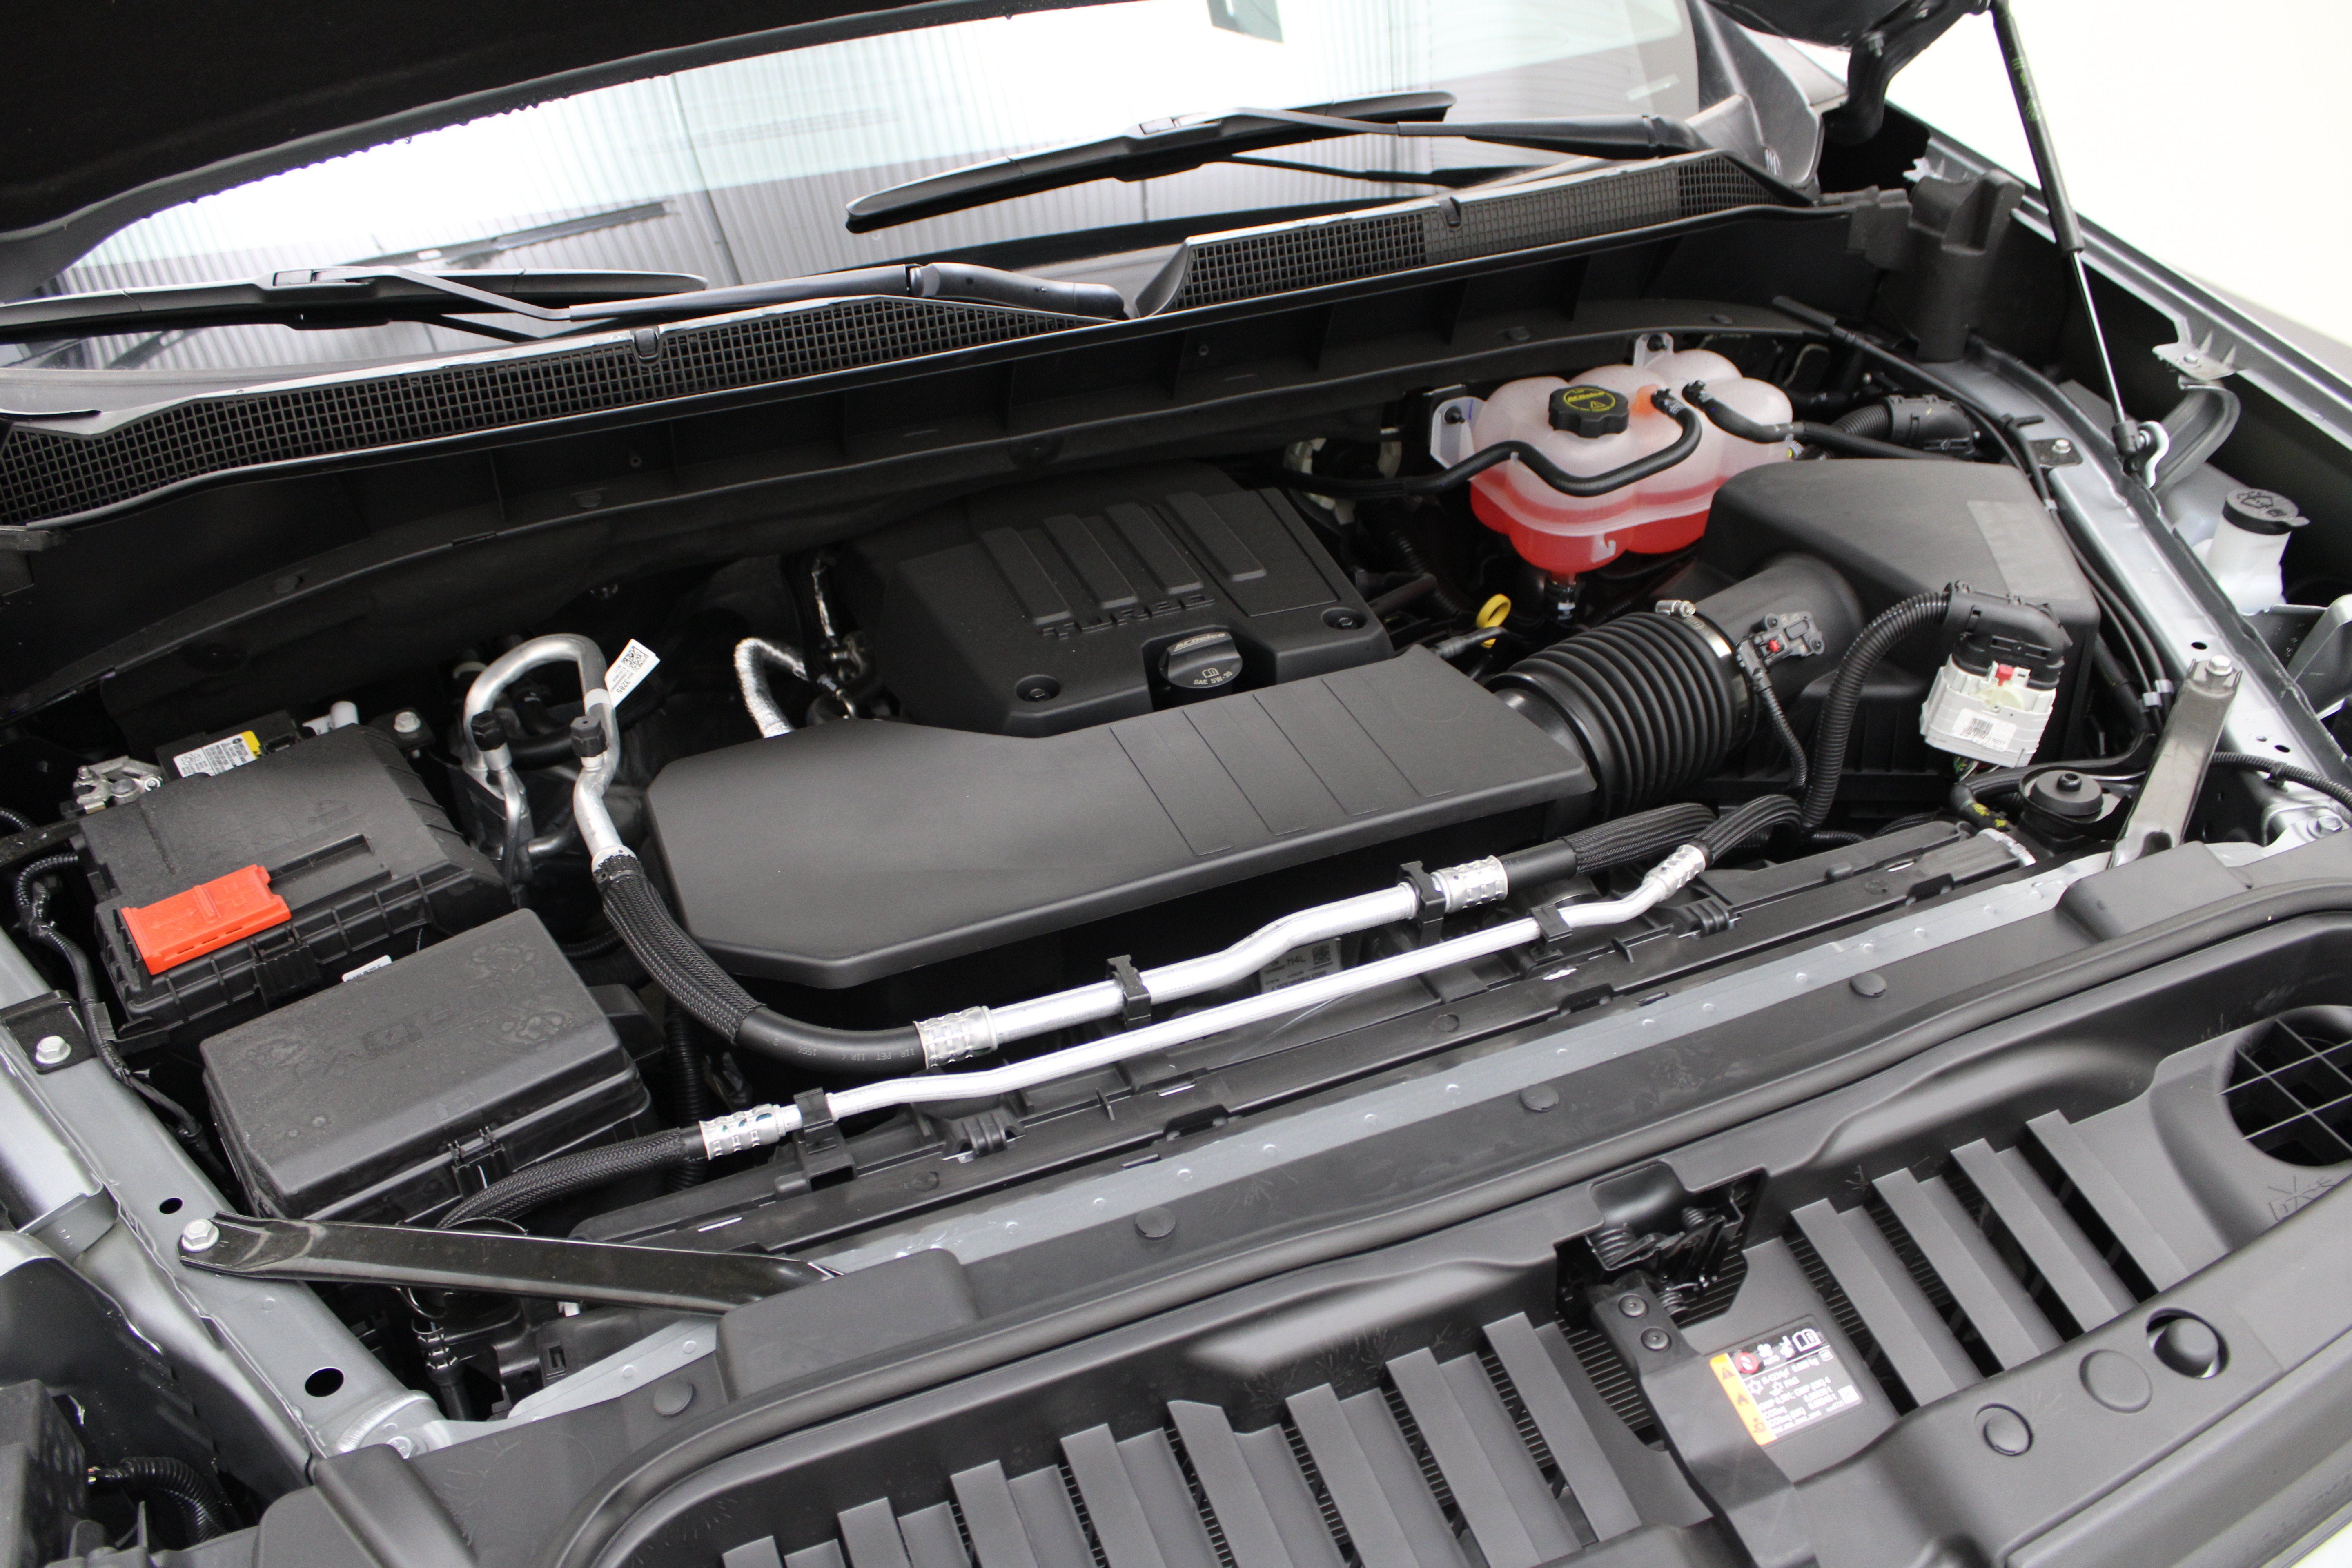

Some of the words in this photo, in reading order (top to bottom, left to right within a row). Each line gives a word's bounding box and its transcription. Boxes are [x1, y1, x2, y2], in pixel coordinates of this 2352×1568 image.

[1042, 595, 1215, 640] TURBO
[1174, 633, 1226, 653] ACDelco
[875, 1052, 891, 1060] PET
[1763, 1355, 1780, 1366] AUTO
